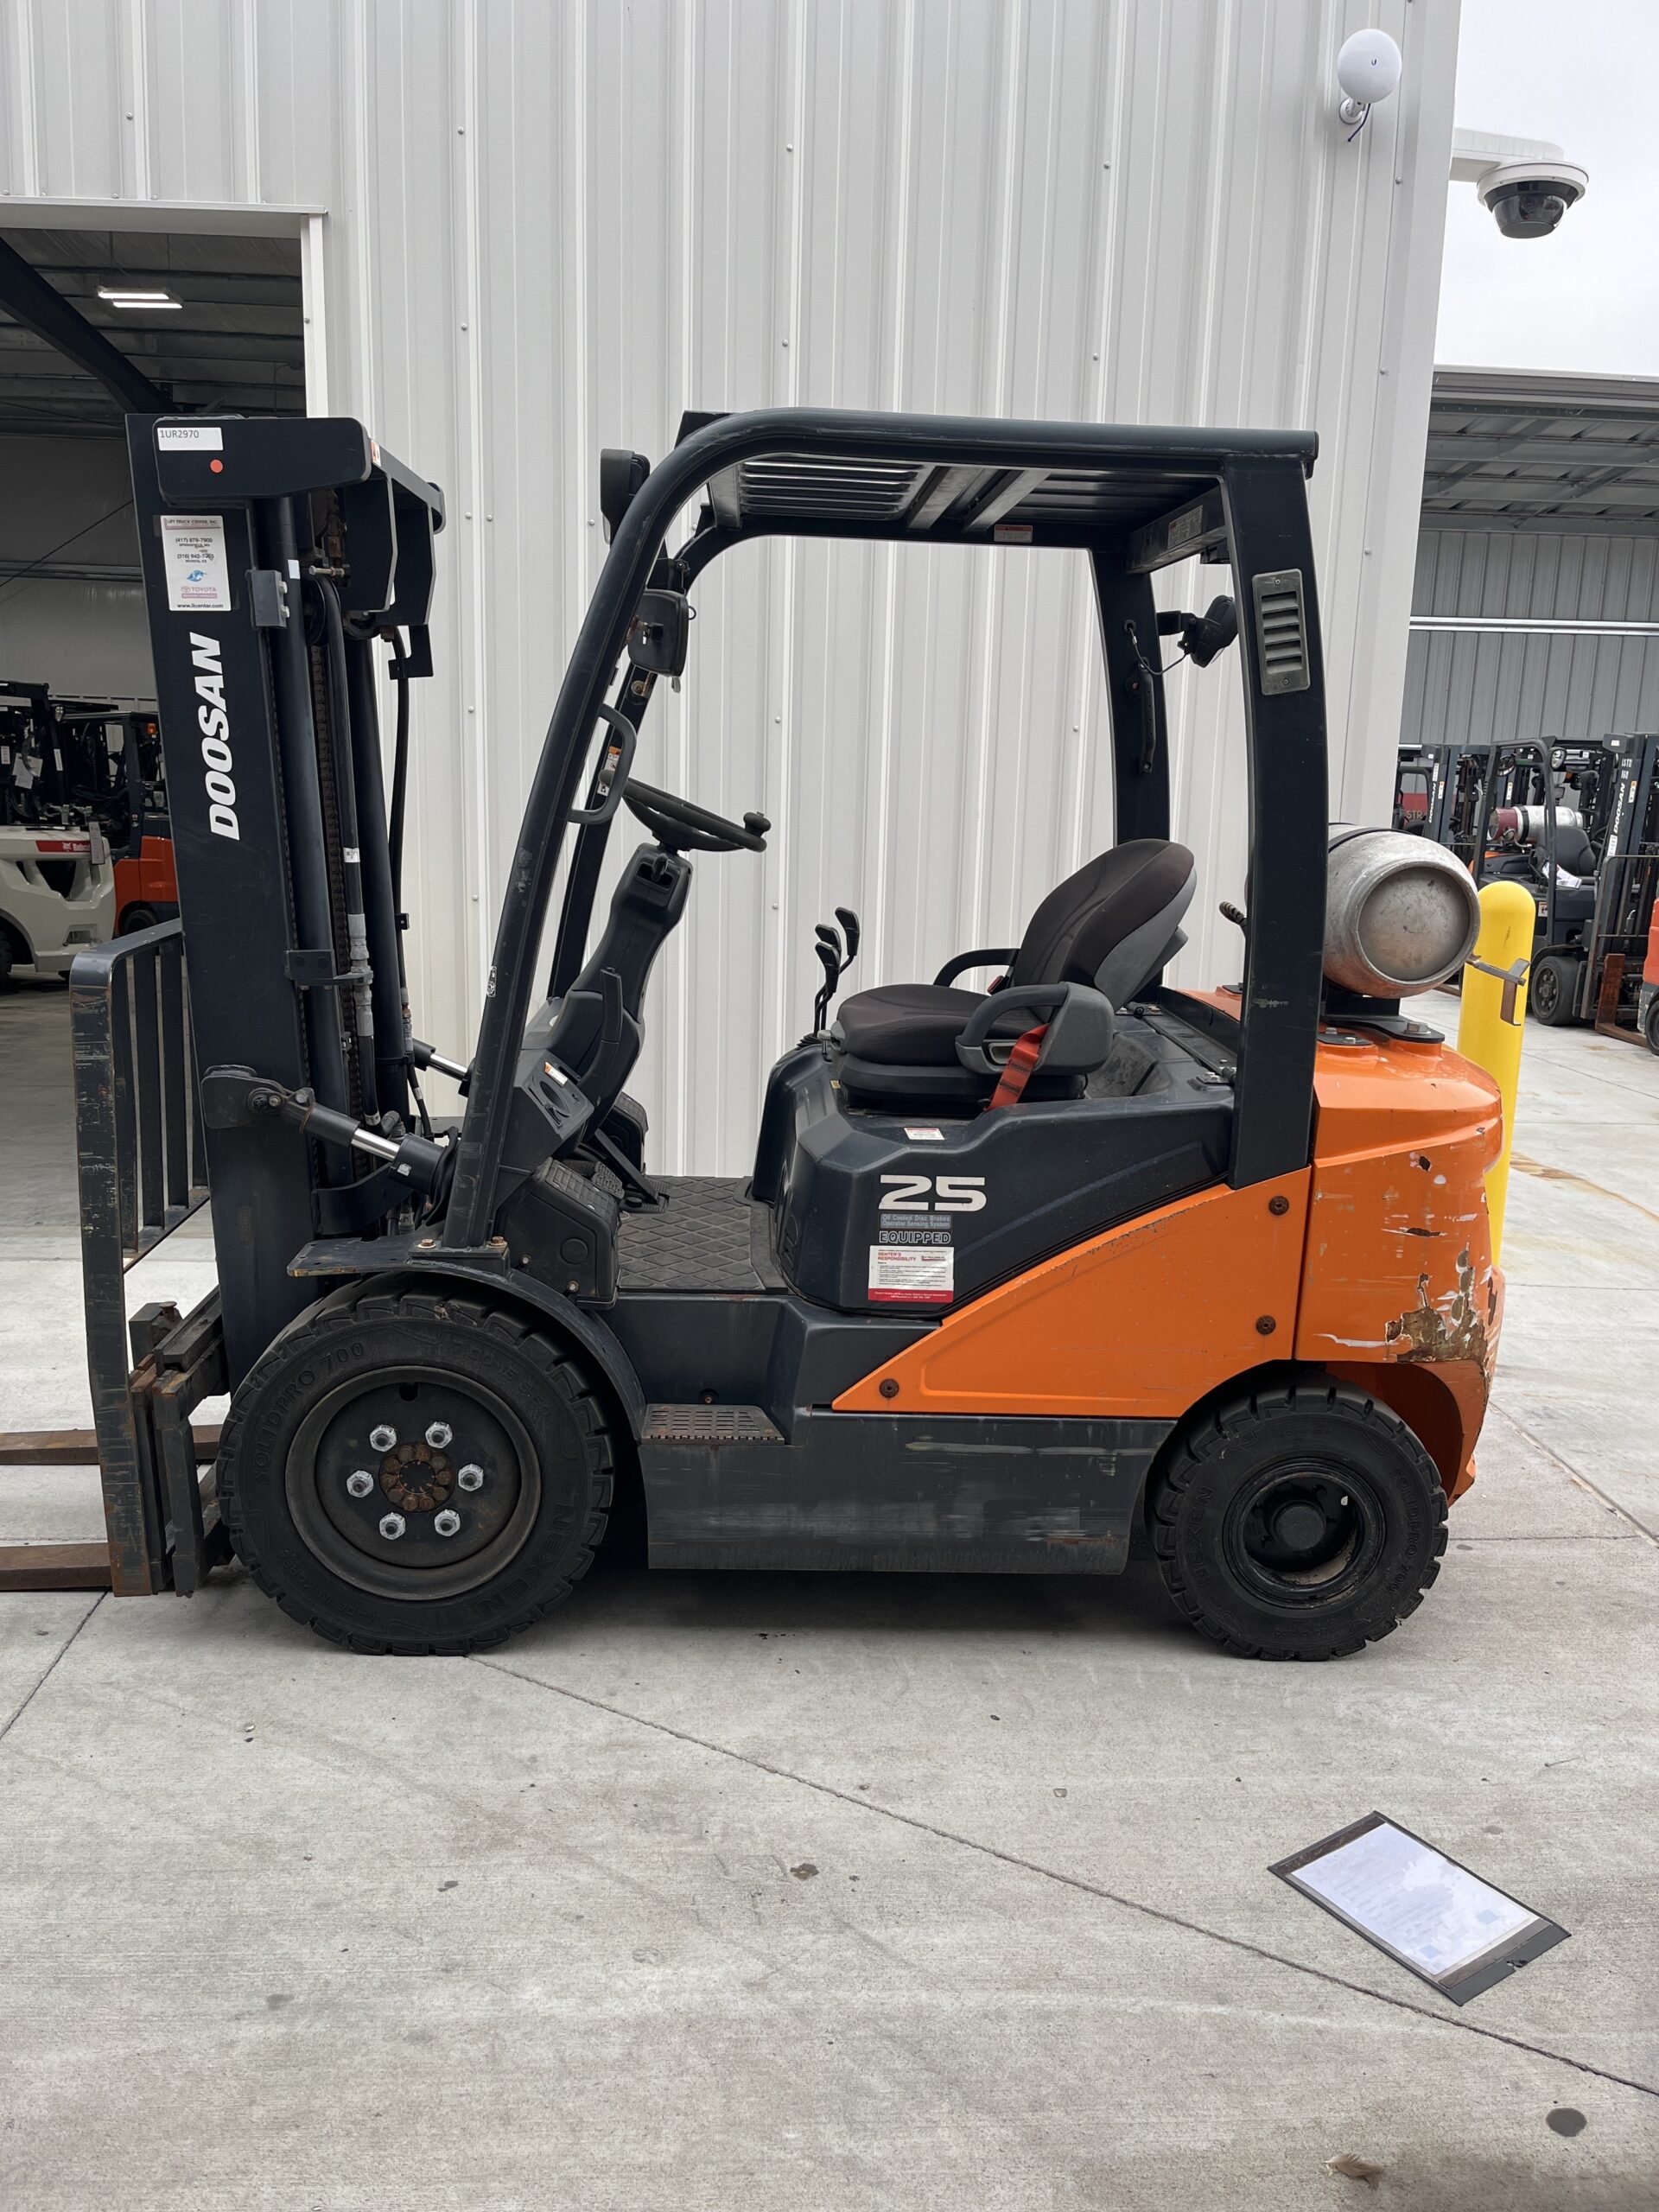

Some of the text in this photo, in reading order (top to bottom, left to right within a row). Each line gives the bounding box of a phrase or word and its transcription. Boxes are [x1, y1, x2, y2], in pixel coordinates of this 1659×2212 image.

[160, 429, 200, 438] 1UR2970
[189, 632, 240, 841] DOOSAN
[1613, 782, 1625, 835] DOOSAN
[878, 1174, 987, 1211] 25
[879, 1230, 951, 1244] EQUIPPED
[252, 1342, 365, 1484] SOLIDPRO 700
[476, 1502, 575, 1618] NEXEN
[1188, 1485, 1217, 1587] NEXEN
